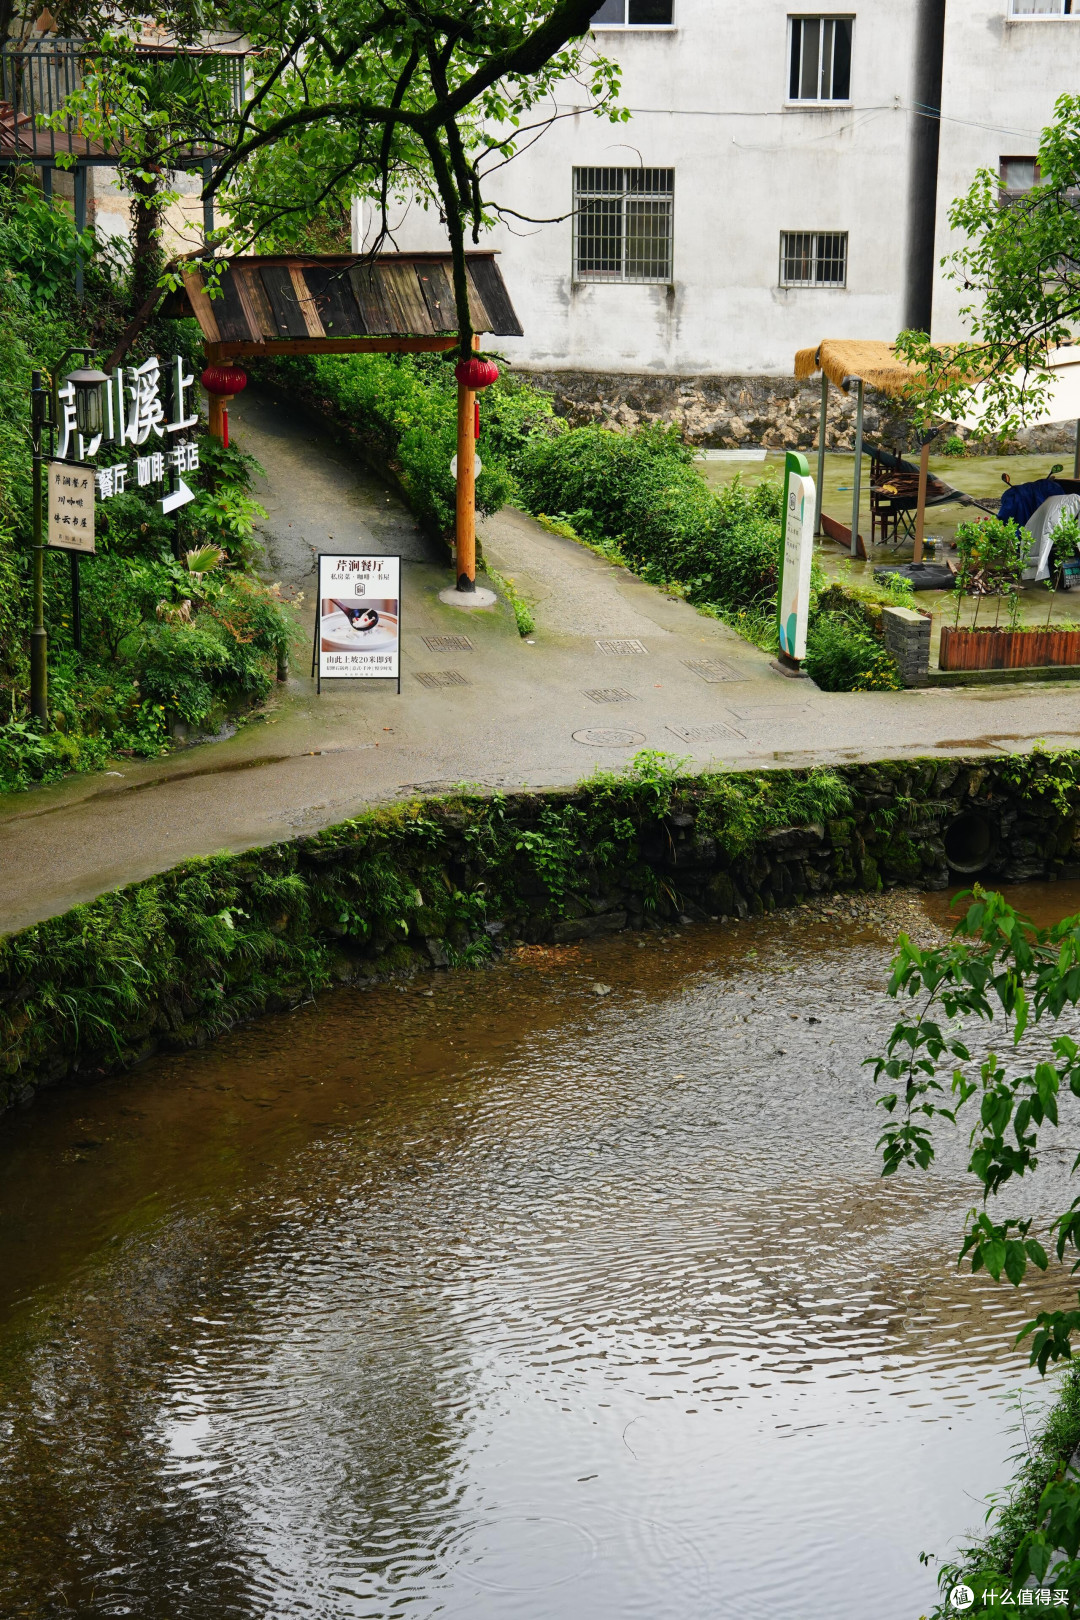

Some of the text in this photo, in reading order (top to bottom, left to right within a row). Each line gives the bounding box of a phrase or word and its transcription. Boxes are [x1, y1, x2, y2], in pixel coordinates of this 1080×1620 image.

[97, 442, 199, 500] 餐厅 咖啡 书店
[336, 559, 384, 572] 芹涧餐厅
